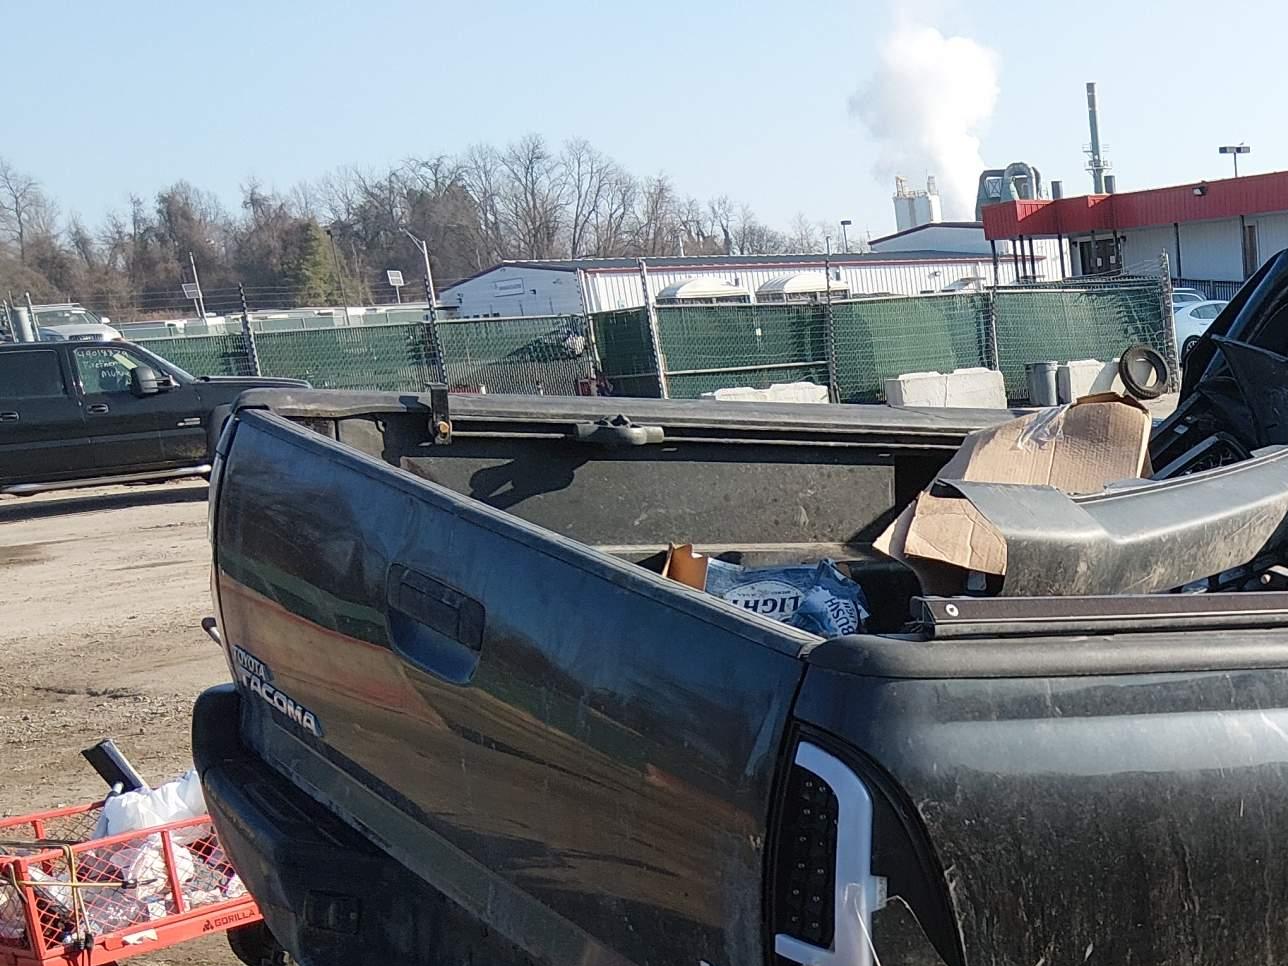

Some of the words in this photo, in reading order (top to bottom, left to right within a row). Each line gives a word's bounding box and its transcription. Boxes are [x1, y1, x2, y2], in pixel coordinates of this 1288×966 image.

[732, 596, 801, 614] LIGH
[232, 645, 267, 681] TOYOTA
[240, 667, 321, 737] TACOMA
[214, 909, 256, 928] GORILLA
